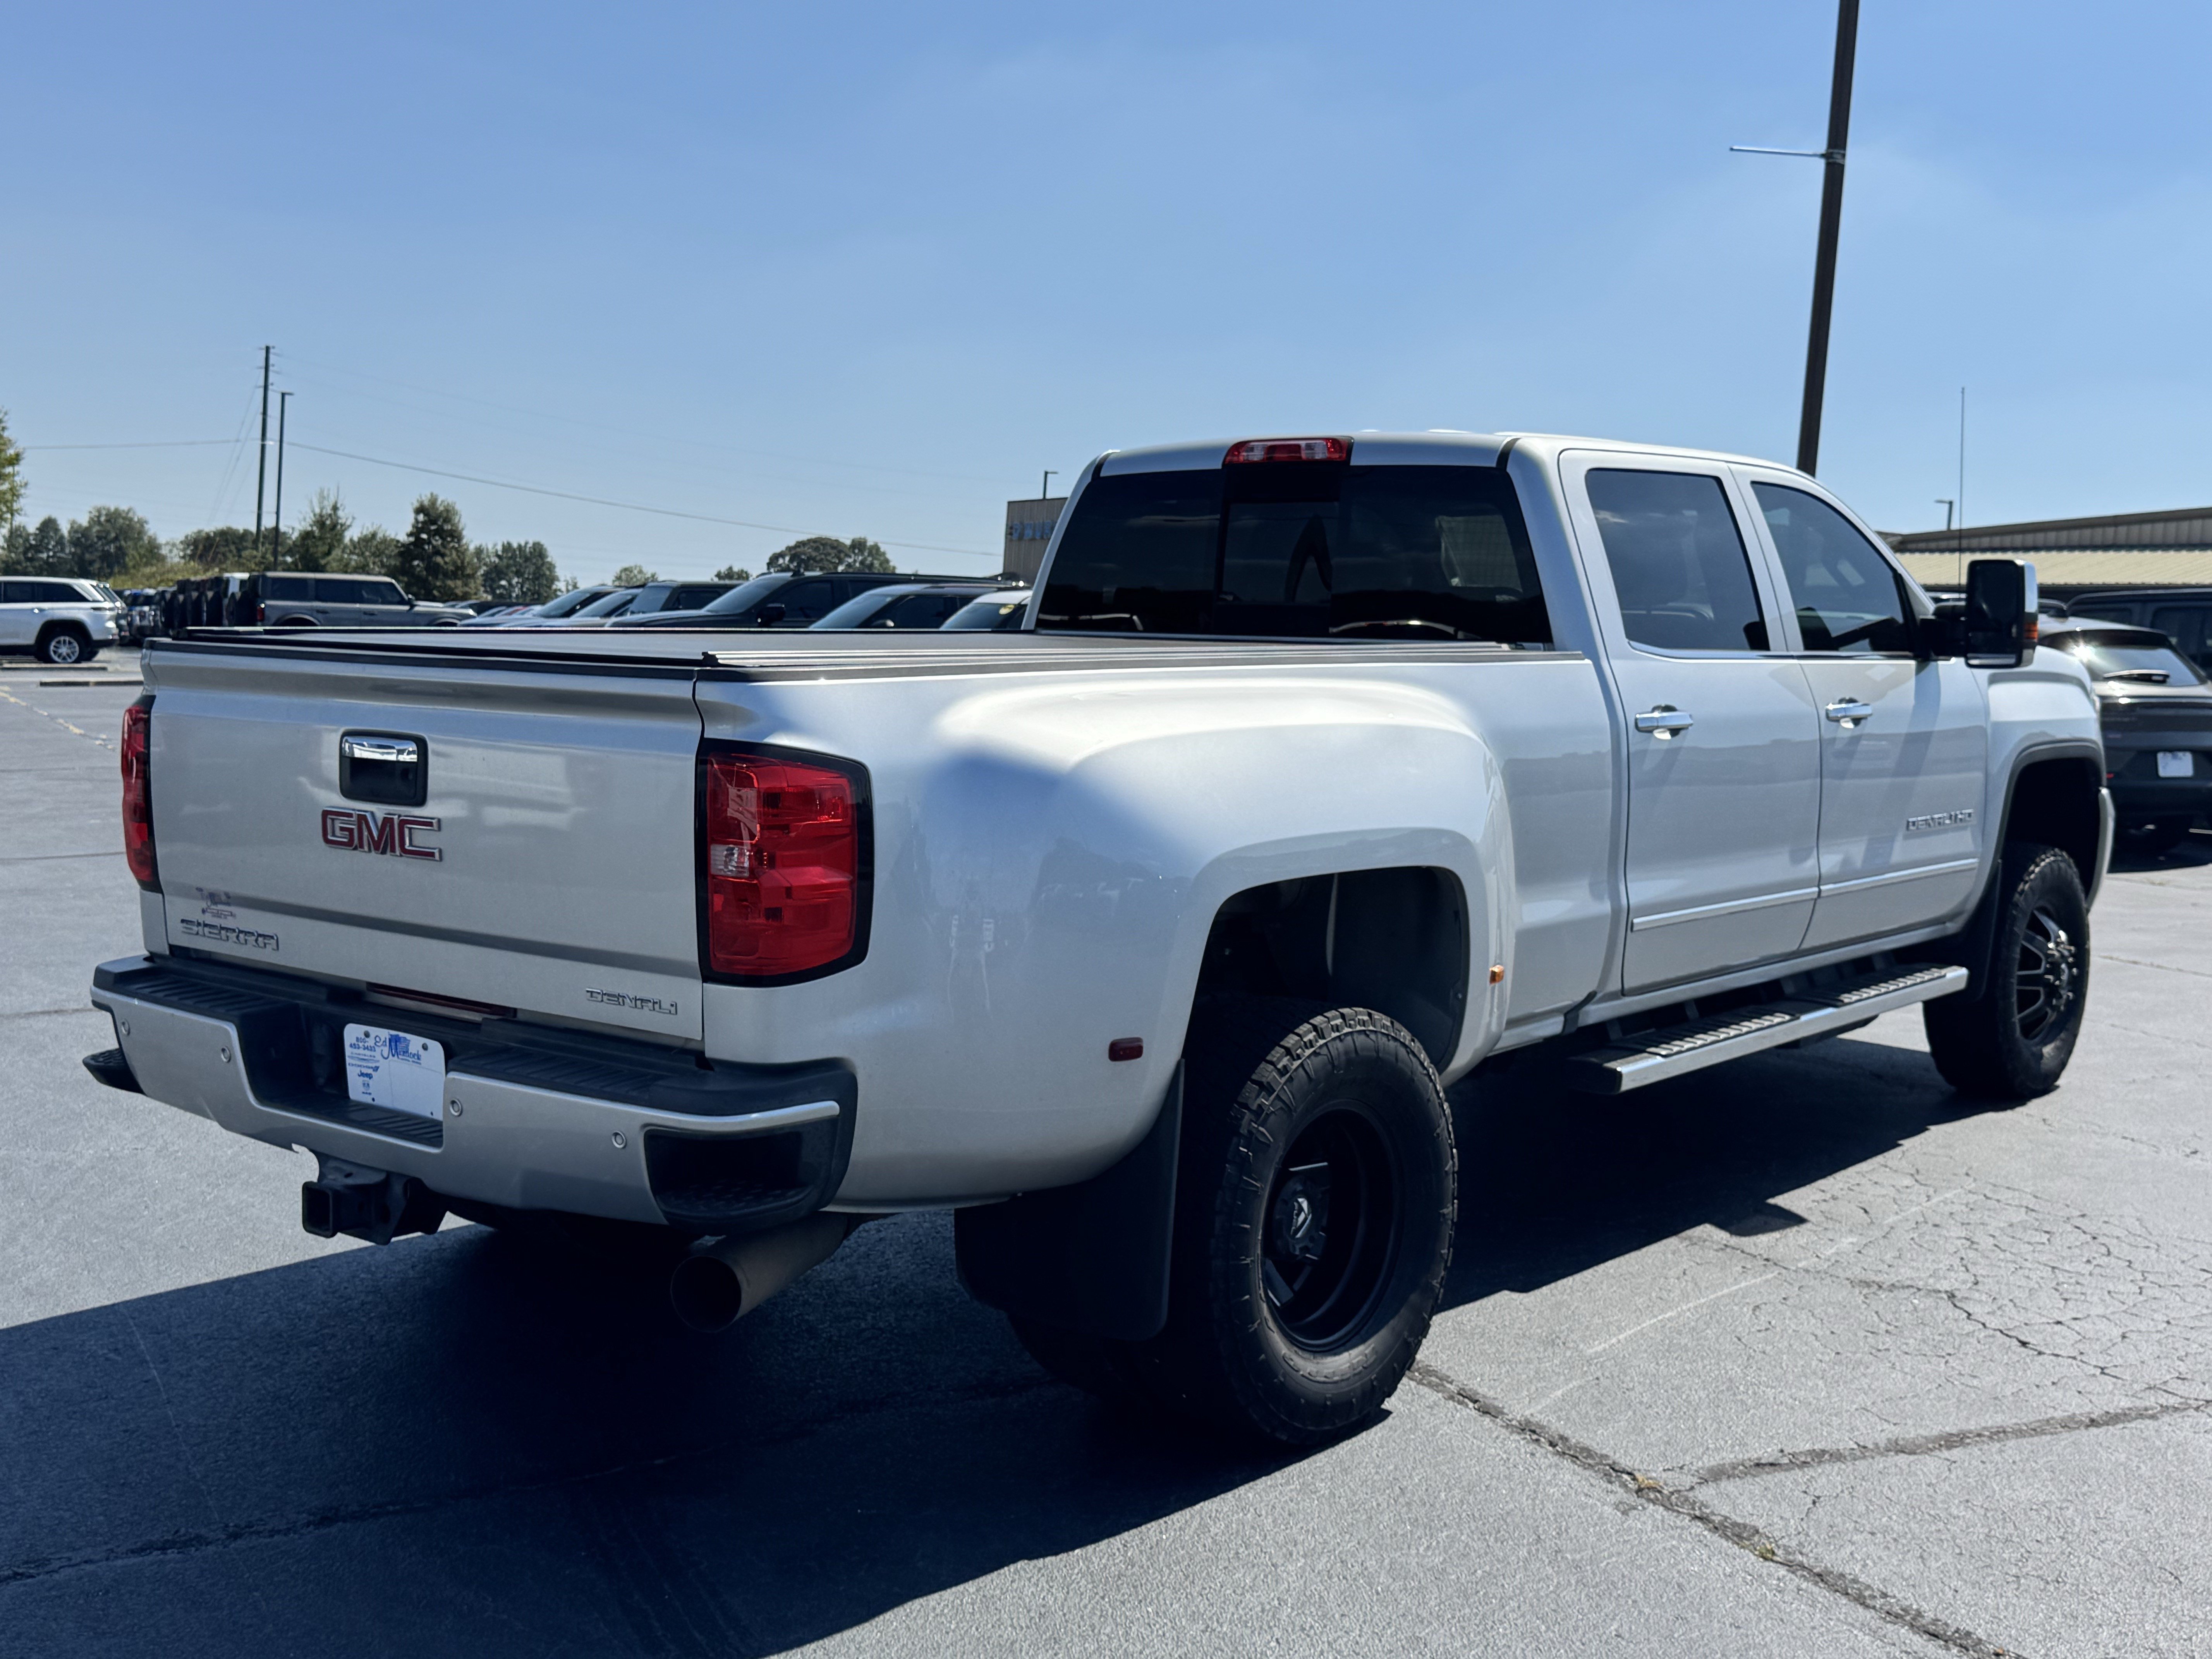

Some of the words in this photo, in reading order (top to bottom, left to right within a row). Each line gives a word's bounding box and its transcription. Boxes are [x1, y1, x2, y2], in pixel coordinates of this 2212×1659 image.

[321, 806, 442, 862] GMC
[180, 919, 279, 951] SIERRA
[586, 987, 678, 1015] DENALI
[374, 1035, 387, 1047] Ed
[357, 1070, 373, 1080] Jeep
